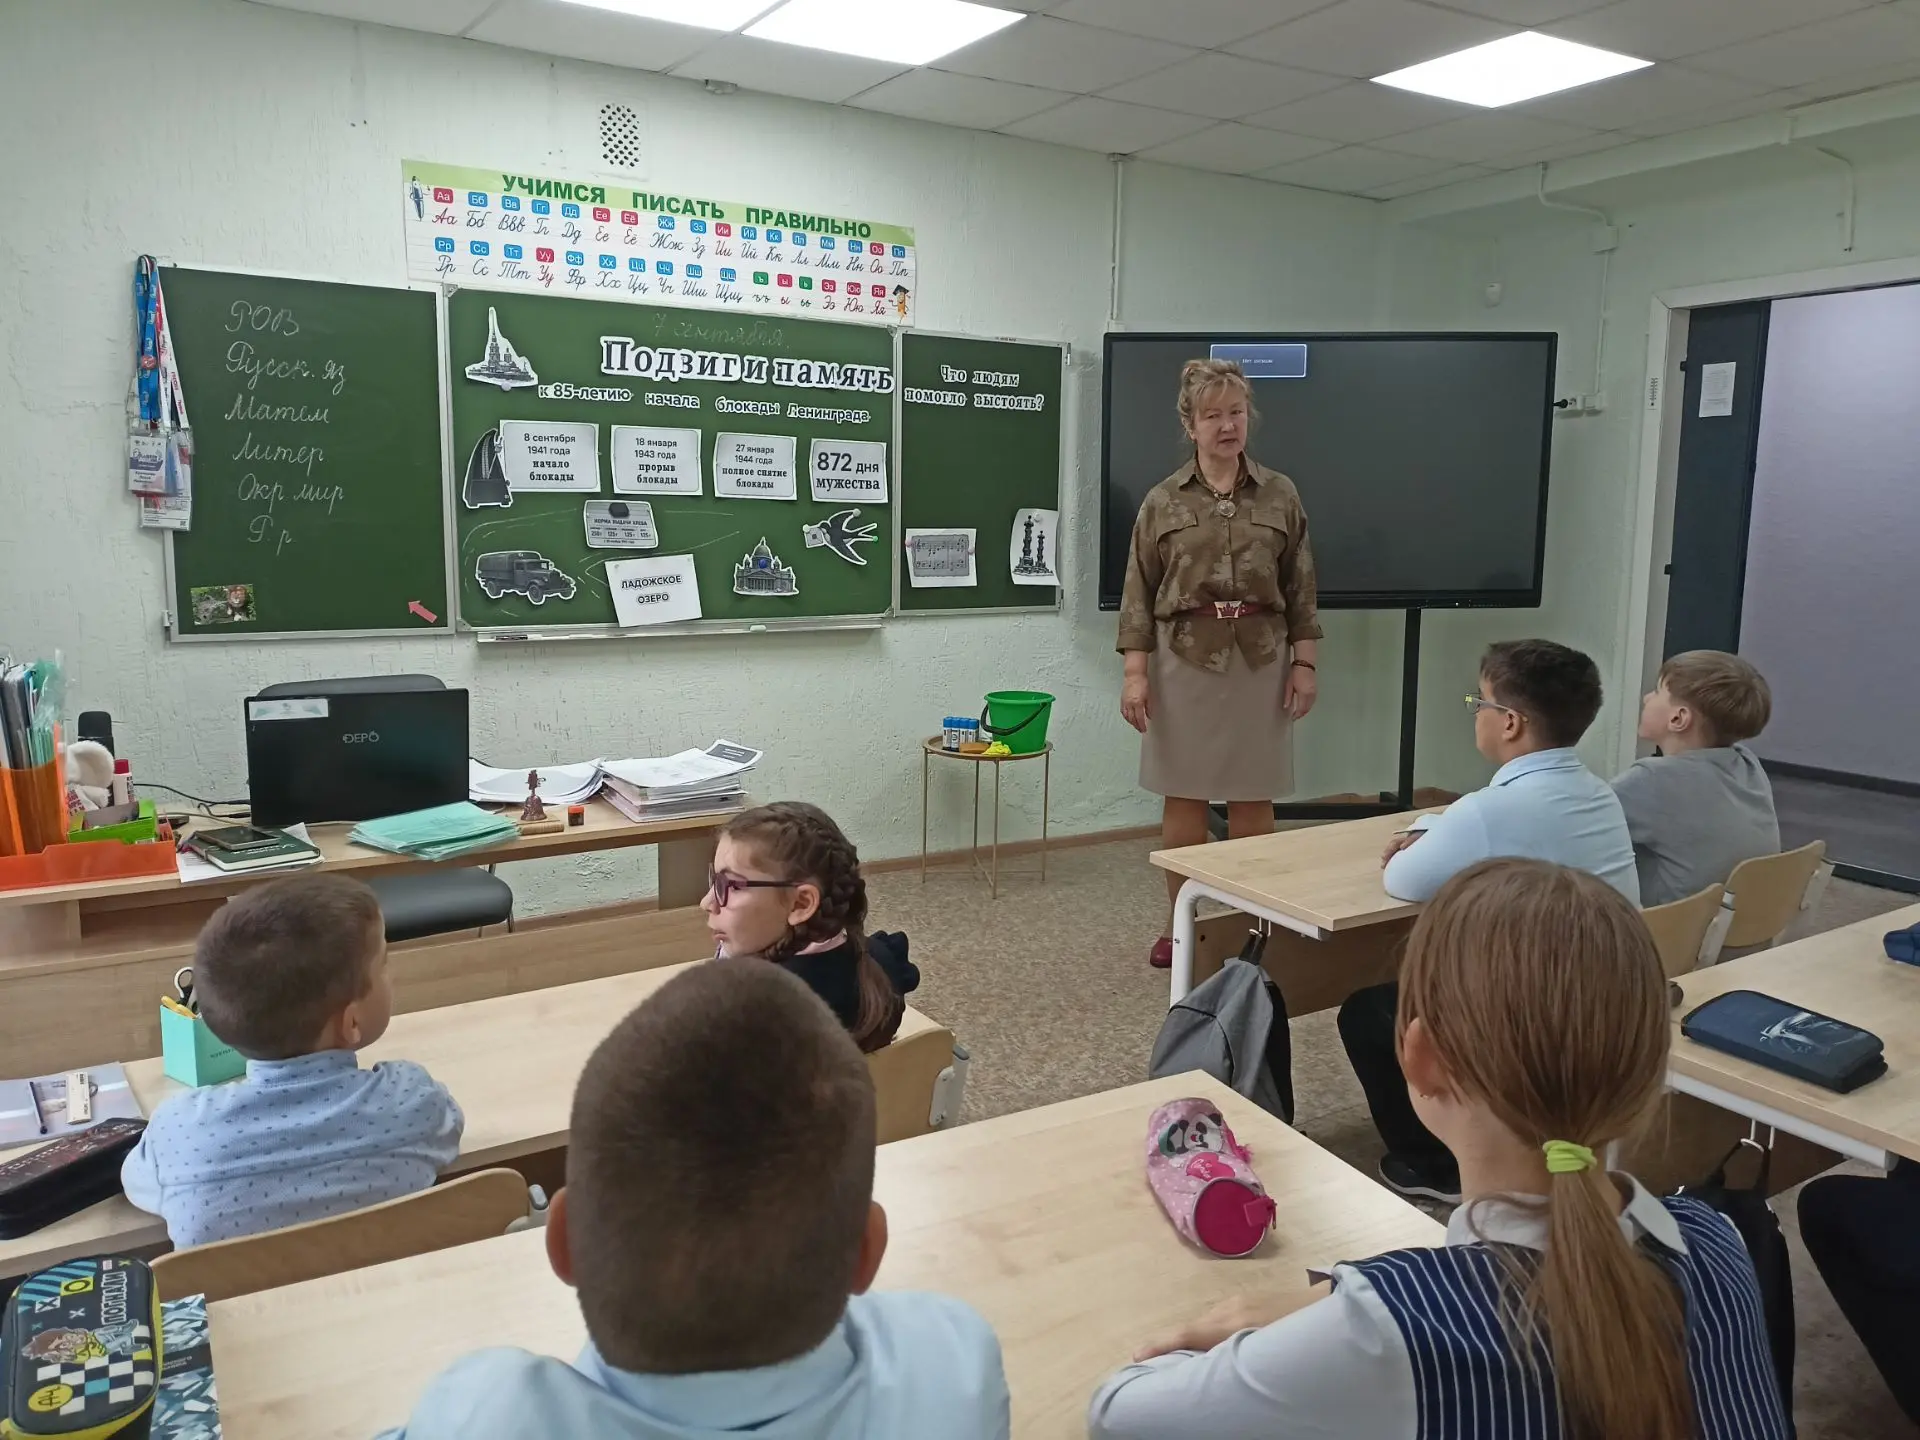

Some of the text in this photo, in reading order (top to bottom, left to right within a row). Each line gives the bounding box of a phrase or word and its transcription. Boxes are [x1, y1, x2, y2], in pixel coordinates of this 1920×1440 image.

[502, 174, 871, 238] УЧИМСЯ ПИСАТЬ ПРАВИЛЬНО
[436, 192, 450, 200] Аа
[471, 196, 484, 205] Бб
[505, 199, 517, 209] Вв
[535, 203, 546, 212] Гг
[564, 207, 577, 217] Дд
[596, 210, 608, 220] Ее
[660, 218, 673, 228] Жж
[694, 222, 703, 232] Зз
[717, 225, 729, 234] Ии
[743, 228, 755, 238] Йй
[769, 231, 779, 240] Кк
[795, 235, 805, 244] Лл
[822, 239, 834, 248] Мм
[850, 242, 861, 251] Нн
[872, 245, 882, 253] Оо
[894, 248, 904, 257] Пп
[432, 208, 457, 225] Аа
[466, 210, 492, 227] Бб
[533, 218, 549, 235] Гг
[562, 222, 582, 244] Дд
[596, 226, 610, 242] Ее
[650, 232, 684, 251] Жж
[692, 236, 705, 259] Зз
[715, 241, 732, 256] Ии
[741, 241, 758, 259] Йй
[766, 246, 783, 262] Кк
[791, 250, 808, 265] Лл
[815, 253, 840, 269] Мм
[846, 256, 864, 272] Нн
[870, 259, 883, 273] Оо
[889, 261, 908, 276] Пп
[438, 240, 452, 251] Рр
[473, 245, 486, 253] Сс
[507, 248, 519, 257] Тт
[539, 251, 552, 262] Уу
[567, 254, 583, 265] Фф
[601, 257, 614, 267] Хх
[631, 260, 644, 270] Цц
[659, 263, 670, 272] Чч
[687, 266, 702, 276] Шш
[721, 270, 736, 280] Щщ
[825, 282, 834, 290] Ээ
[848, 284, 861, 293] Юю
[874, 288, 884, 296] Яя
[435, 255, 456, 278] Рр
[472, 259, 488, 276] Сс
[537, 265, 554, 288] Уу
[565, 269, 586, 290] Фф
[595, 271, 621, 288] Хх
[628, 274, 649, 294] Цц
[659, 277, 675, 294] Чч
[682, 280, 708, 297] Шш
[716, 284, 743, 303] Щщ
[823, 295, 835, 310] Ээ
[844, 298, 864, 312] Юю
[871, 301, 886, 315] Яя
[744, 359, 766, 381] и
[776, 362, 892, 390] память
[942, 366, 1018, 386] Что людям
[540, 385, 870, 423] к 85-летию начала блокады Ленинграда
[906, 390, 1044, 409] помогло выстоять?
[224, 394, 330, 424] Матем
[524, 434, 576, 444] 8 сентября
[636, 438, 677, 448] 18 января
[528, 446, 570, 456] 1941 года
[635, 450, 676, 460] 1943 года
[736, 444, 774, 454] 27 января
[532, 460, 570, 468] начало
[735, 455, 773, 465] 1944 года
[817, 452, 879, 474] 872 дня
[638, 464, 676, 473] прорыв
[722, 468, 787, 477] полное снятие
[529, 472, 574, 482] блокады
[637, 476, 678, 485] блокады
[736, 479, 774, 488] блокады
[816, 477, 880, 491] мужества
[622, 576, 682, 588] ЛАДОЖСКОЕ
[638, 594, 669, 604] ОЗЕРО
[343, 731, 379, 743] DEPO
[102, 1272, 126, 1324] ПОГНАЛИ
